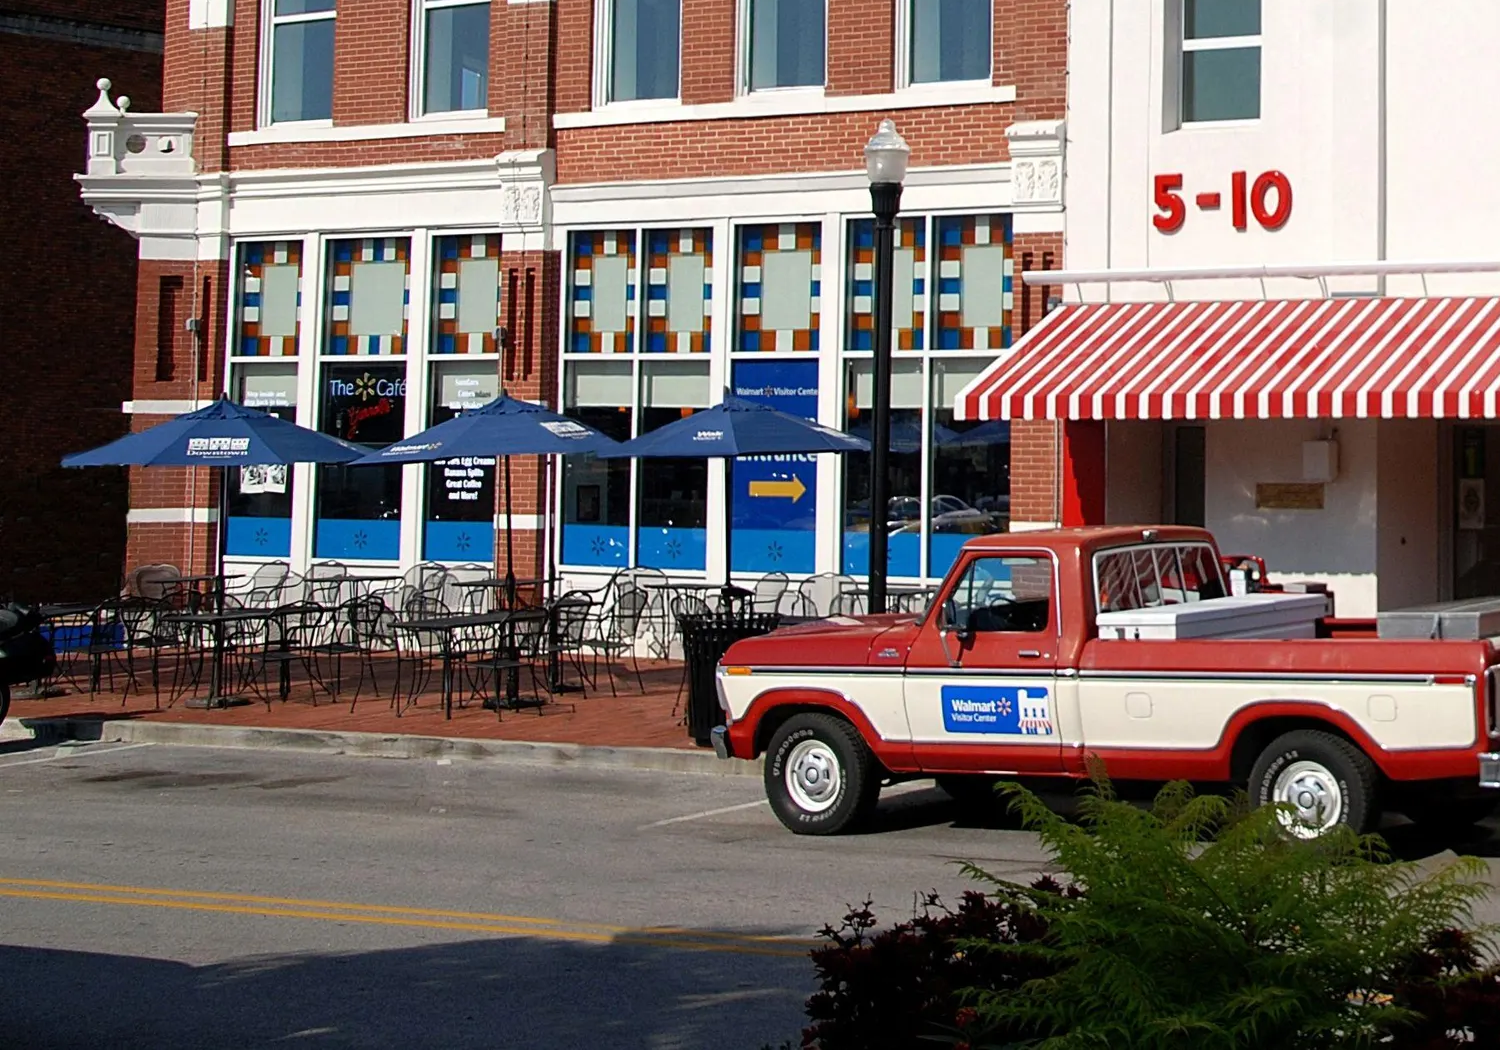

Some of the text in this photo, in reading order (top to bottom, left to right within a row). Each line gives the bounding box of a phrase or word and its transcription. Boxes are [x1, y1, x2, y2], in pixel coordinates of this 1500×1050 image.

[1153, 170, 1293, 235] 5-10
[330, 379, 354, 396] The
[736, 387, 818, 396] Walmart Visitor Cente
[951, 699, 996, 713] Walmart
[951, 713, 997, 723] Visitor Center
